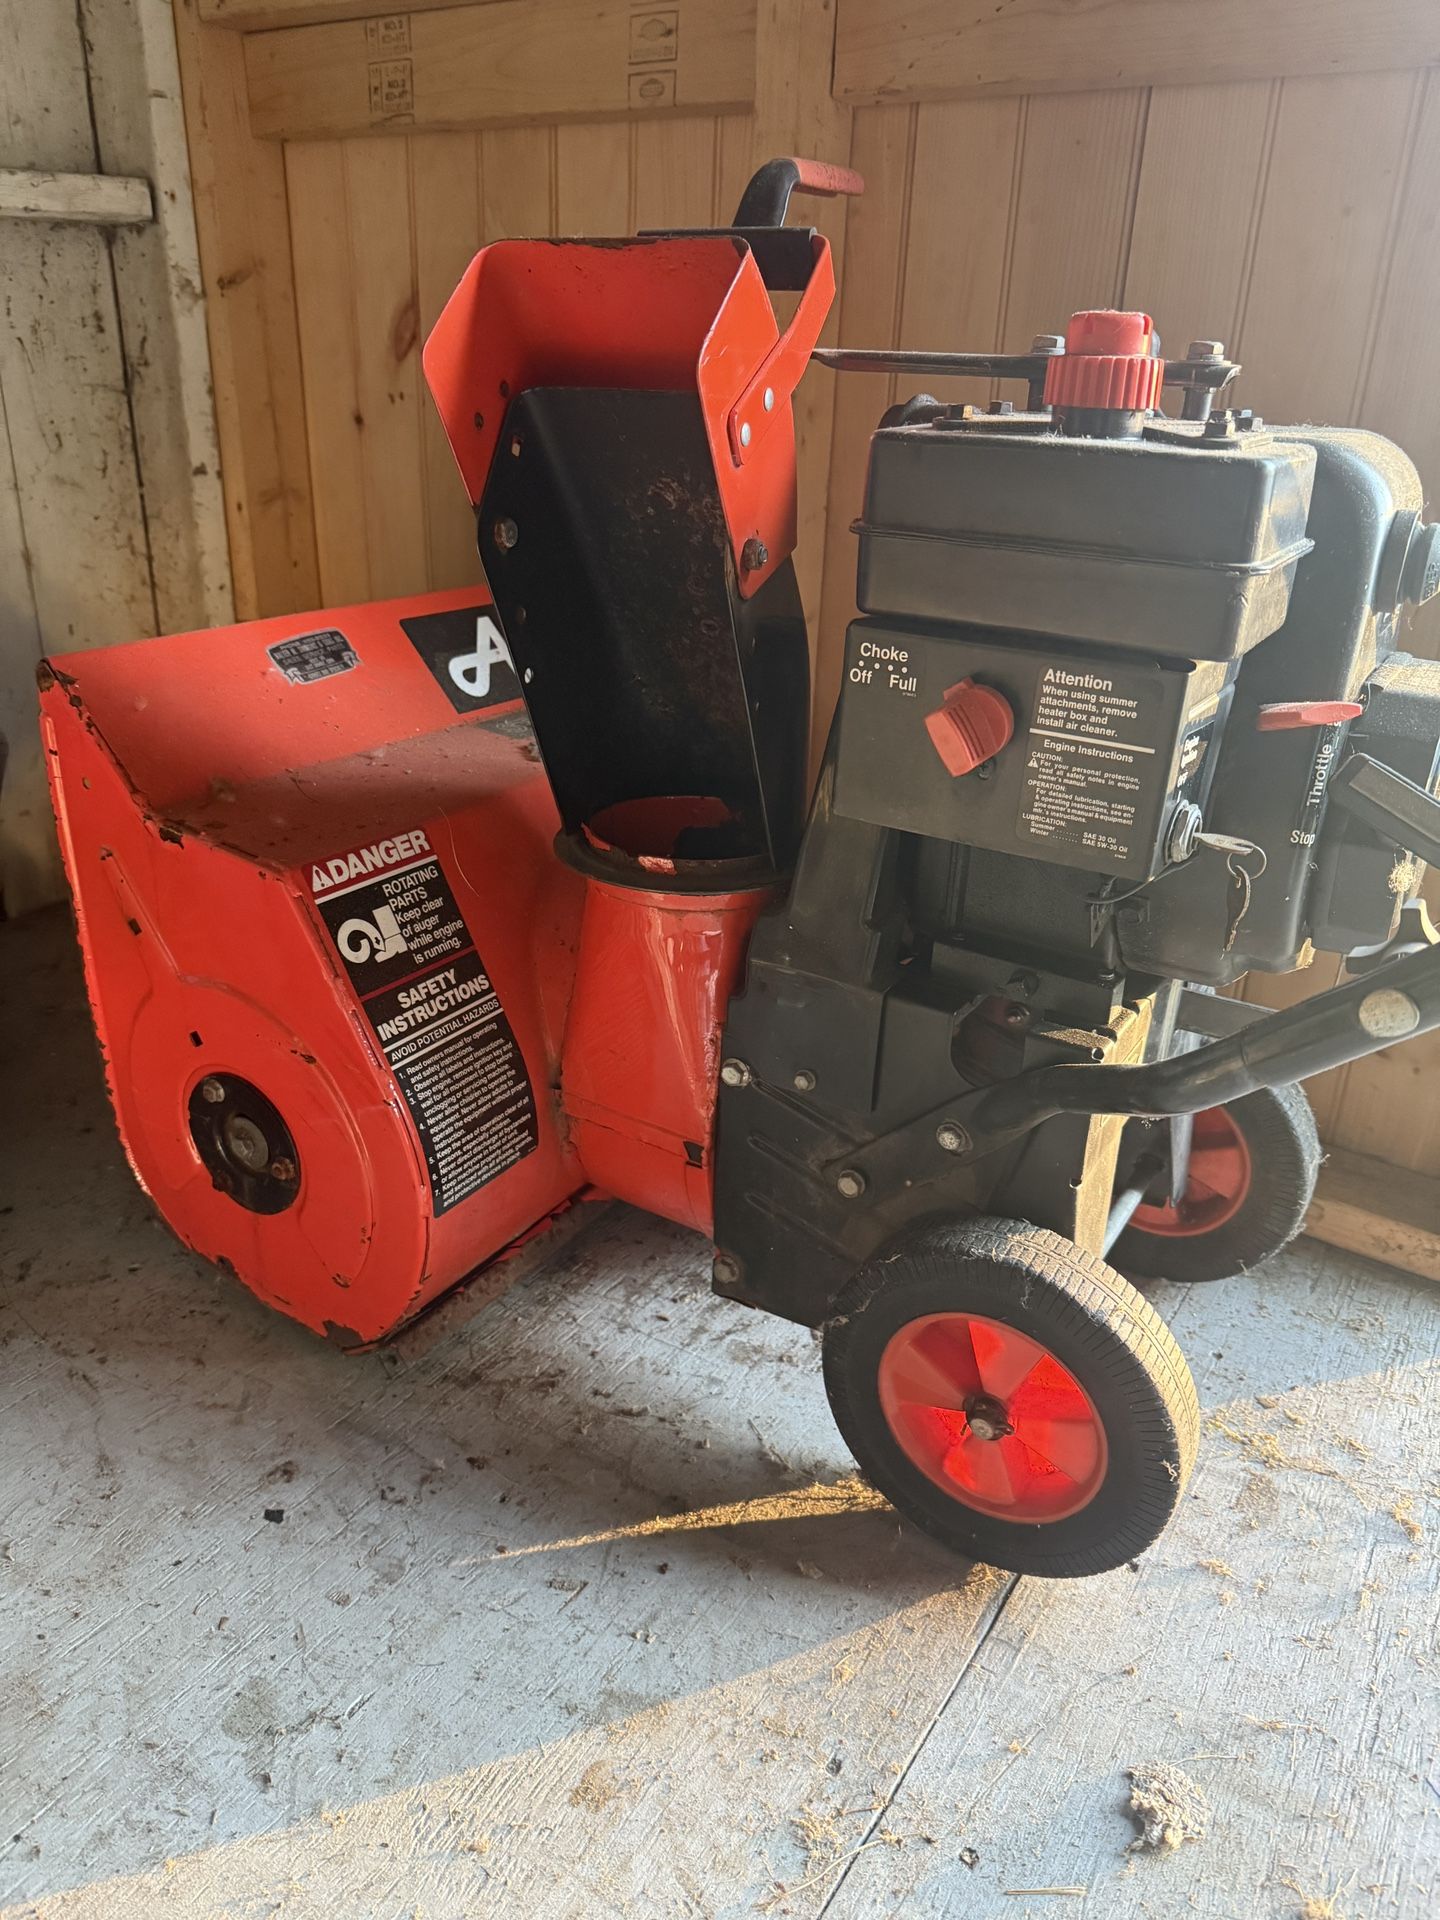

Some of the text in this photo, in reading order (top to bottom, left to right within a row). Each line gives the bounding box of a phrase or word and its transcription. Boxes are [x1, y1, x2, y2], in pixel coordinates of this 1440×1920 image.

[860, 642, 909, 663] Choke
[849, 668, 918, 692] Off Full
[1043, 668, 1112, 691] Attention
[1039, 695, 1137, 719] attachments, remove
[1042, 684, 1138, 708] When using summer
[1036, 715, 1118, 737] install air cleaner.
[1038, 705, 1108, 725] heater box and
[1031, 751, 1063, 762] CAUTION:
[1043, 738, 1134, 763] Engine Instructions
[1037, 773, 1087, 787] owner's manual.
[1039, 759, 1051, 767] For
[1071, 766, 1102, 776] personal
[1103, 772, 1140, 784] protection,
[1066, 772, 1085, 781] safety
[1087, 776, 1105, 784] notes
[1117, 781, 1139, 790] engine
[1306, 743, 1333, 807] Throttle
[1027, 779, 1065, 792] OPERATION:
[1040, 796, 1070, 808] operating
[1070, 801, 1109, 815] instructions,
[1048, 790, 1073, 800] detailed
[1074, 795, 1109, 808] lubrication,
[1111, 803, 1135, 813] starting
[1070, 808, 1094, 817] manual
[1099, 814, 1133, 825] equipment
[1029, 827, 1128, 853] Winter SAE 5W-30 Oil
[1030, 820, 1117, 844] Summer SAE 30 Oil
[1290, 830, 1316, 848] Stop
[326, 829, 430, 885] DANGER
[381, 865, 439, 897] ROTATING
[388, 886, 428, 912] PARTS
[394, 896, 444, 924] Keep clear
[402, 914, 439, 938] of auger
[407, 919, 464, 951] while engine
[412, 936, 462, 964] is running.
[397, 968, 456, 1009] SAFETY
[376, 974, 489, 1041] INSTRUCTIONS
[391, 998, 499, 1062] AVOID POTENTIAL HAZARDS
[405, 1061, 423, 1075] Read
[422, 1051, 444, 1067] owners
[443, 1038, 465, 1055] manual
[463, 1035, 472, 1044] for
[472, 1022, 498, 1039] operating
[410, 1045, 474, 1084] and safety instructions.
[413, 1074, 439, 1092] Observe
[438, 1069, 446, 1078] all
[445, 1061, 463, 1074] labels
[462, 1053, 474, 1065] and
[416, 1088, 432, 1101] Stop
[452, 1065, 473, 1080] remove
[472, 1053, 494, 1069] ignition
[492, 1048, 503, 1057] key
[502, 1040, 513, 1052] and
[420, 1051, 513, 1109] wait for all movement to stop before
[423, 1095, 457, 1120] unclogging
[455, 1090, 462, 1099] or
[462, 1076, 488, 1095] servicing
[426, 1112, 444, 1126] Never
[444, 1103, 459, 1116] allow
[459, 1089, 482, 1107] children
[487, 1074, 507, 1090] operate
[506, 1069, 516, 1078] the
[460, 1101, 477, 1115] Never
[477, 1093, 492, 1105] allow
[491, 1083, 508, 1097] adults
[507, 1079, 514, 1087] to
[431, 1125, 454, 1143] operate
[453, 1120, 463, 1129] the
[463, 1101, 492, 1124] equipment
[510, 1080, 527, 1096] proper
[434, 1128, 466, 1151] instruction.
[436, 1146, 452, 1160] Keep
[451, 1140, 461, 1150] the
[461, 1132, 474, 1144] area
[473, 1127, 480, 1136] of
